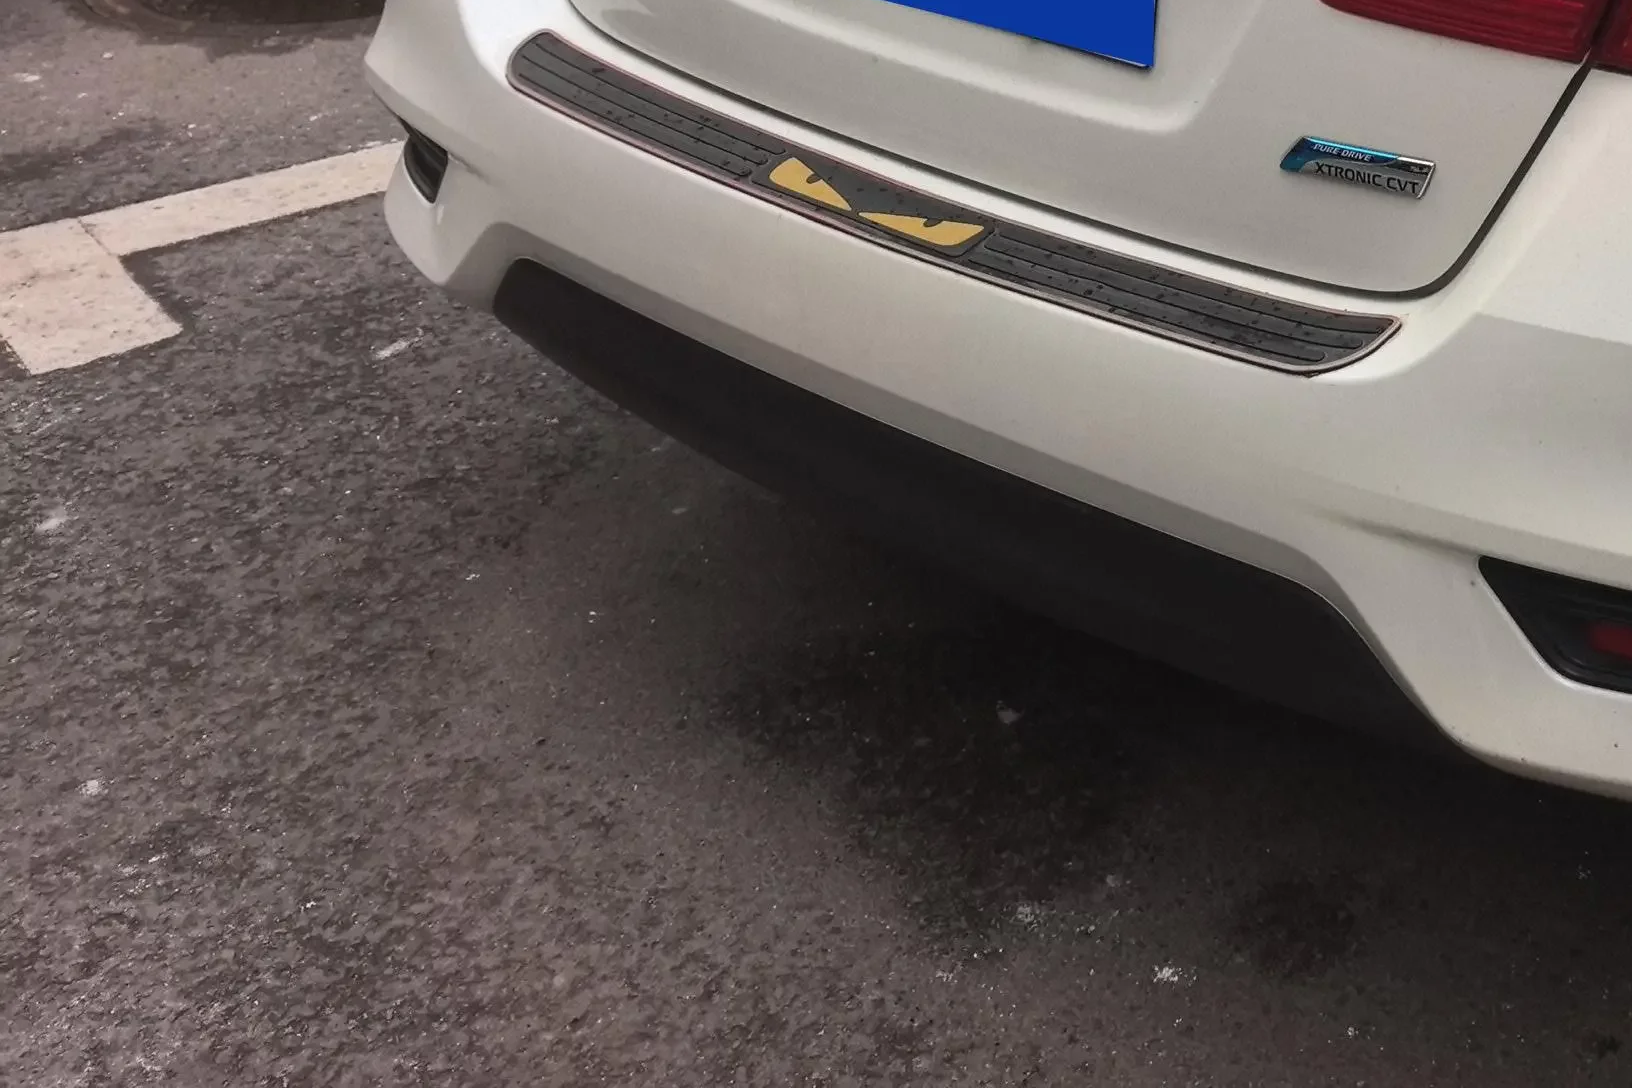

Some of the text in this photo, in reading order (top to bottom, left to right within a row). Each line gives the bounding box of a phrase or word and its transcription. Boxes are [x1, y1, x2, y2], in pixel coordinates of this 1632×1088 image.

[1313, 143, 1372, 162] PURE DRIVE
[1316, 162, 1419, 194] XTRONIC CVT
